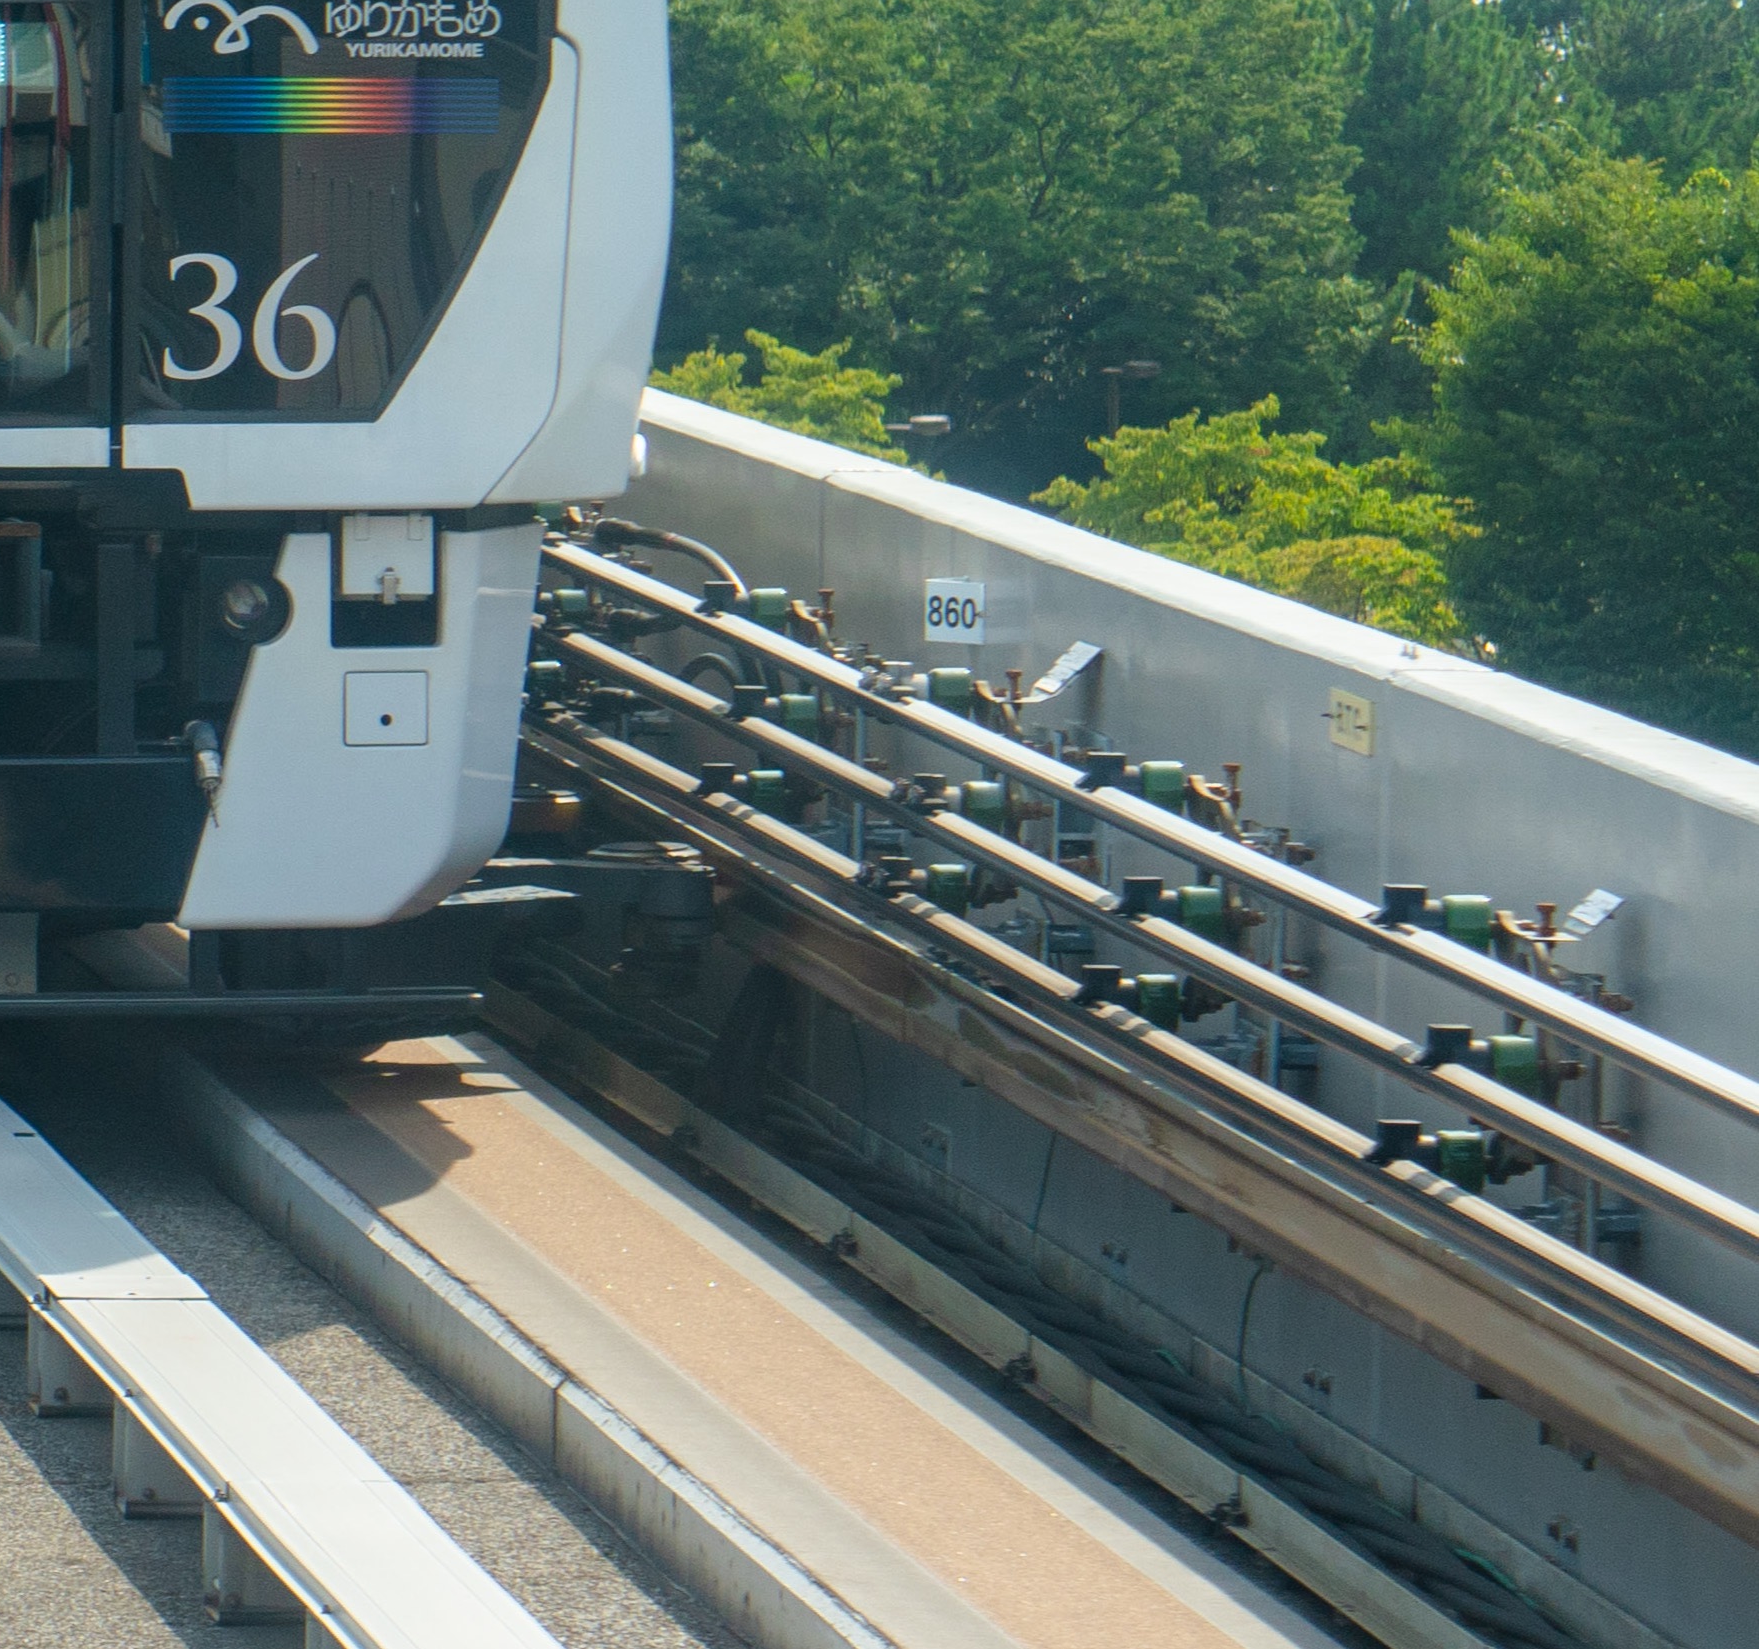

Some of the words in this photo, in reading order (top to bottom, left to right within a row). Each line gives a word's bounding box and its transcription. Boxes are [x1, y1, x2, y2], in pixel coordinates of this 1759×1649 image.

[345, 43, 484, 58] YURIKAMOME
[163, 253, 336, 380] 36
[928, 595, 976, 630] 860
